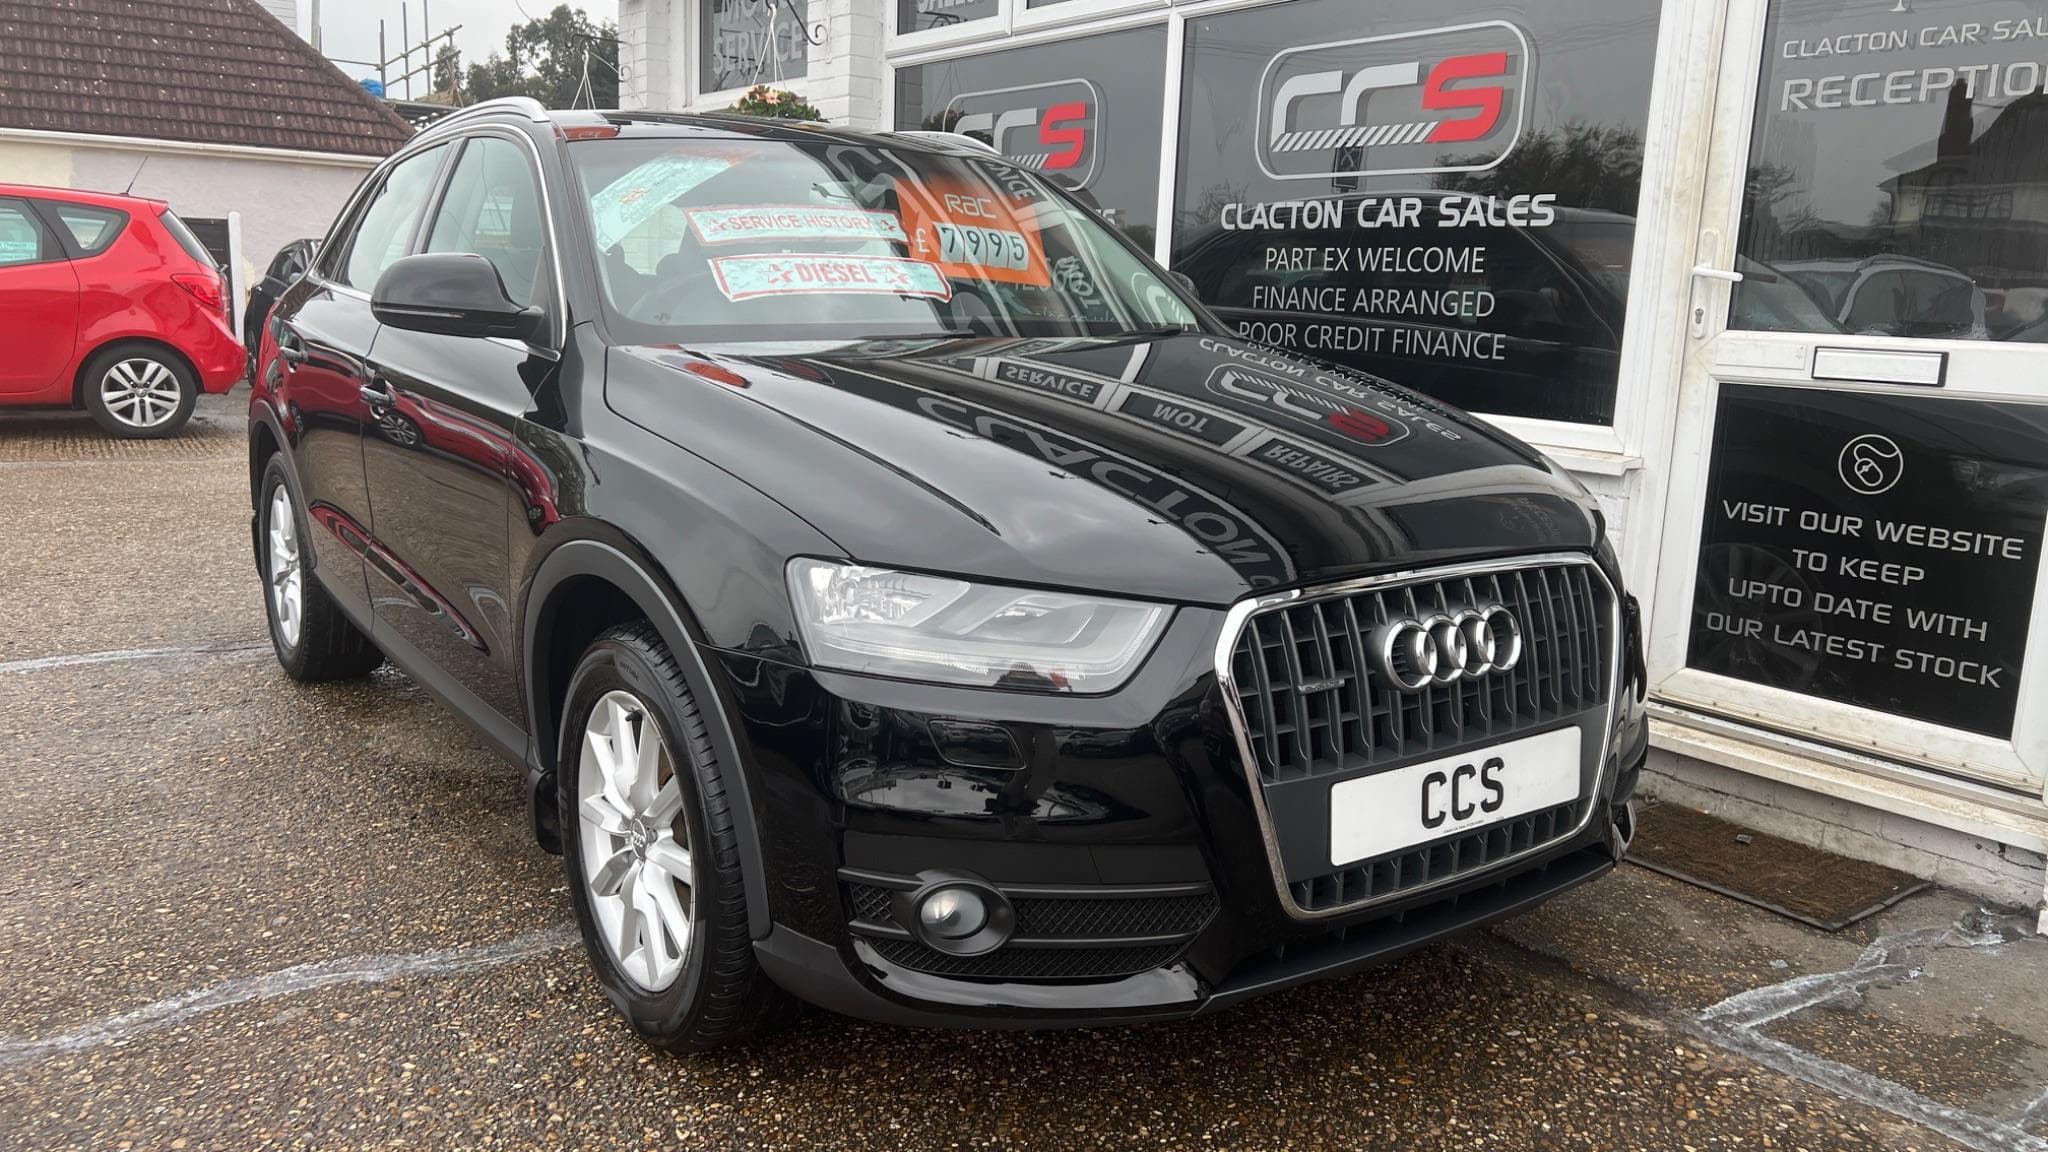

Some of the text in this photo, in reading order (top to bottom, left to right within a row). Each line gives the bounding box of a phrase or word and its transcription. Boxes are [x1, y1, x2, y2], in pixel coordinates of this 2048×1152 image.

[713, 20, 803, 74] SERVICE
[1783, 17, 2048, 59] CLACTON CAR SAL
[1781, 61, 2048, 112] RECEPTIO
[728, 214, 873, 231] SERVICE HISTORY
[1221, 193, 1556, 231] CLACTON CAR SALES
[916, 227, 1025, 262] £ 7995
[1265, 246, 1486, 273] PART EX WELCOME
[794, 262, 876, 284] DIESEL
[1253, 285, 1495, 317] FINANCE ARRANGED
[1238, 321, 1297, 348] POOR
[1304, 324, 1385, 352] CREDIT
[1392, 329, 1506, 361] FINANCE
[1723, 499, 2024, 560] VISIT OUR WEBSITE
[1792, 548, 1926, 586] TO KEEP
[1728, 577, 1988, 642] UPTO DATE WITH
[1706, 612, 2003, 689] OUR LATEST STOCK
[1421, 757, 1505, 829] CCS
